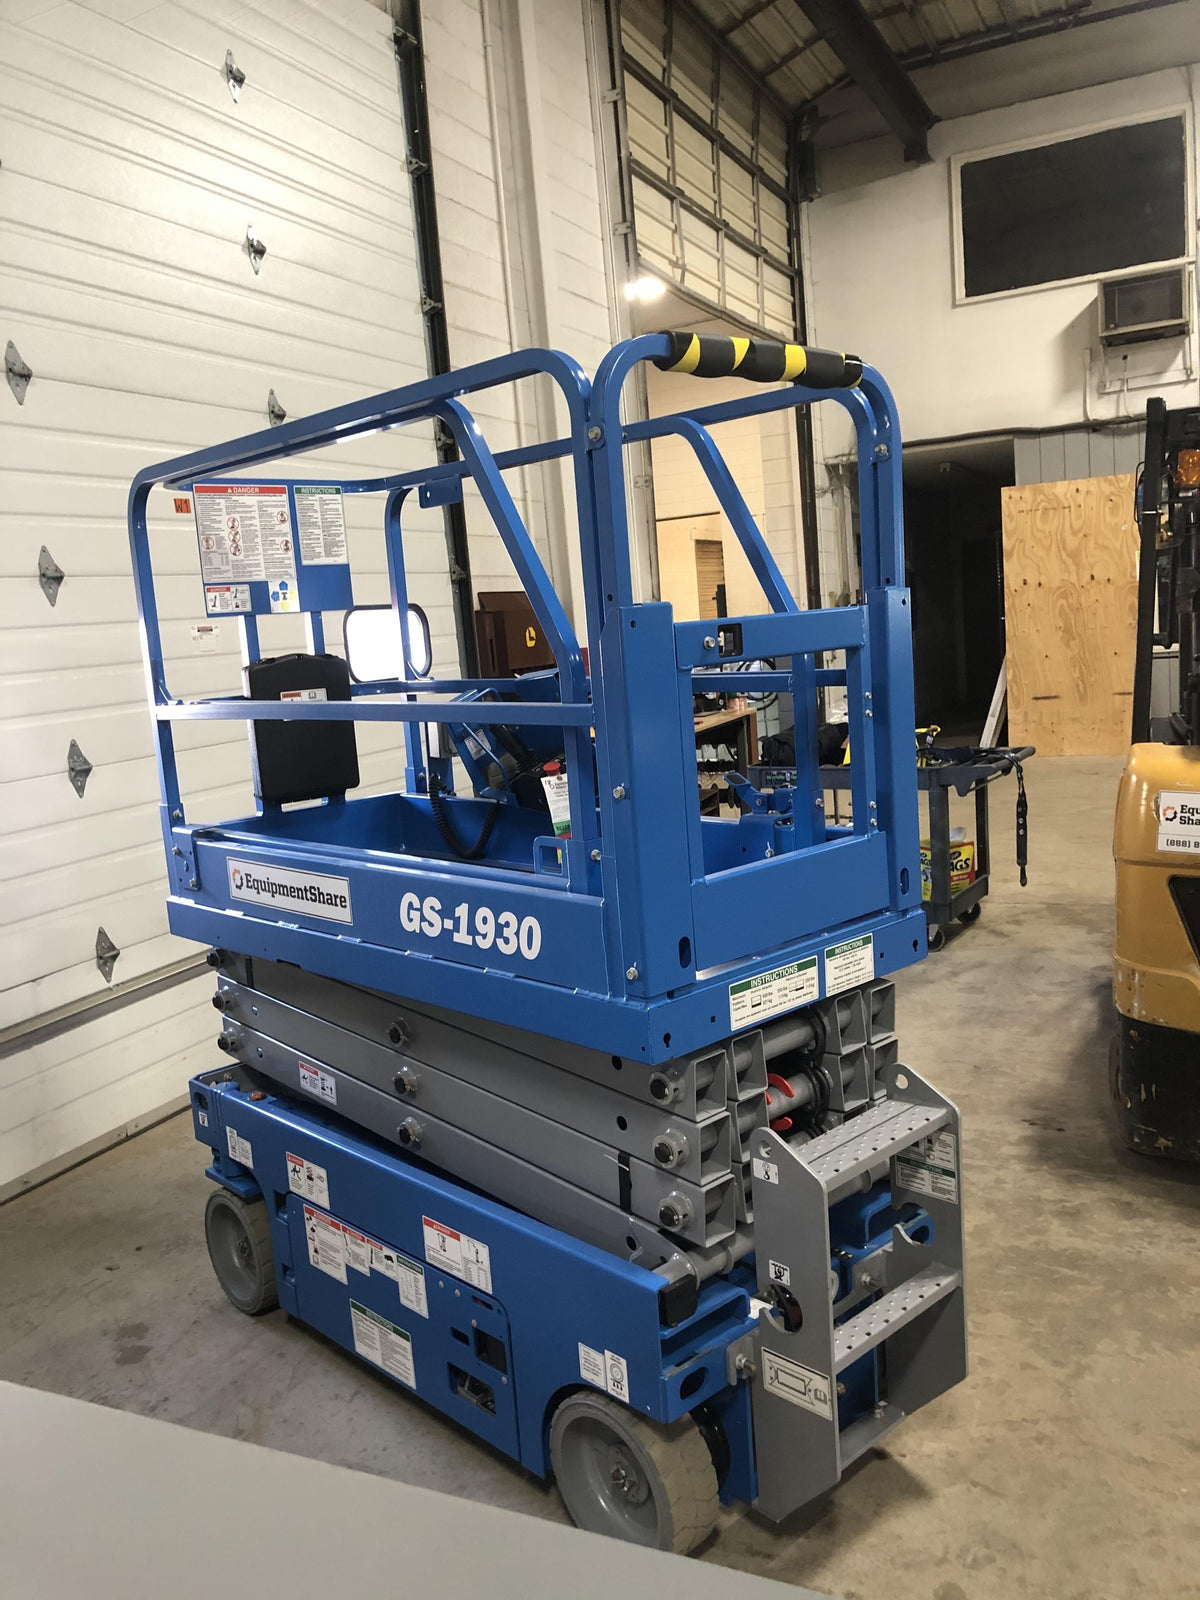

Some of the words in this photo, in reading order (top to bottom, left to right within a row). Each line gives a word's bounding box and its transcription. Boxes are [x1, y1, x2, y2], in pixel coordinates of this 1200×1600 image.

[950, 857, 970, 872] AGS
[243, 872, 348, 910] EquipmentShare
[398, 891, 542, 961] GS-1930
[834, 939, 864, 955] INSTRUCTIONS
[750, 964, 799, 988] INSTRUCTIONS
